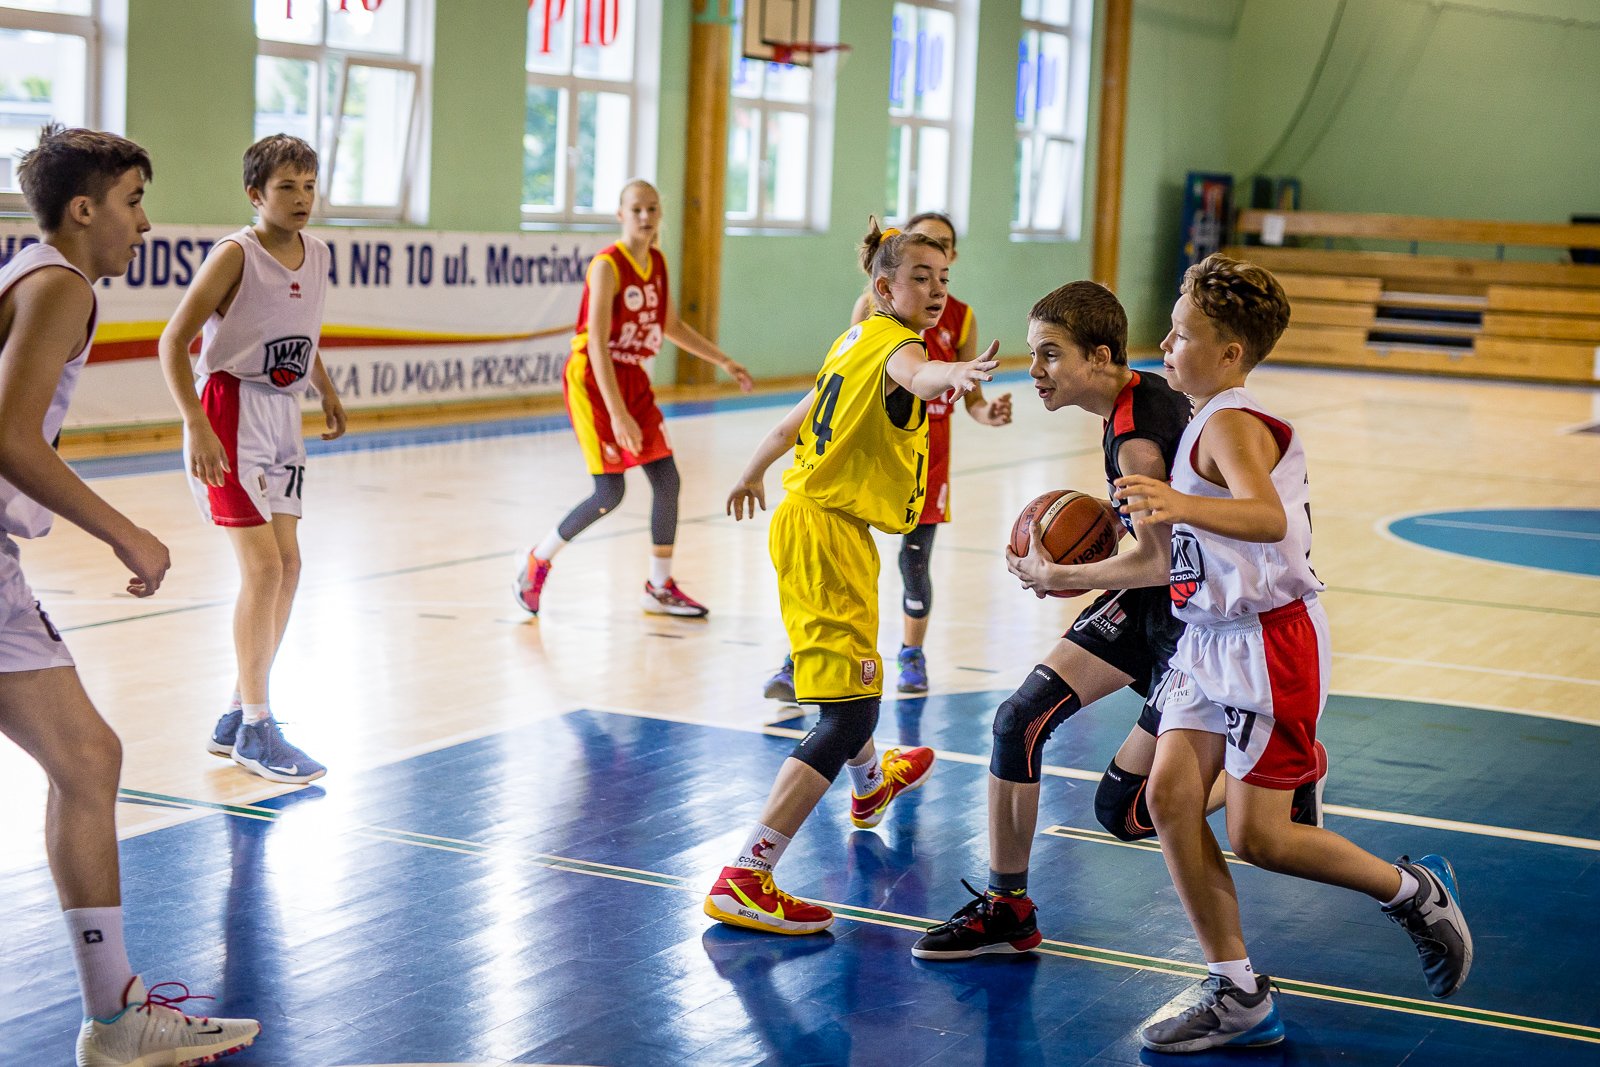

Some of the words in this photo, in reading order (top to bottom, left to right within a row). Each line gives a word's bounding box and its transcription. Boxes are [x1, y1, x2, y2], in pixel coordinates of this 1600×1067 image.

[351, 242, 391, 287] NR
[405, 243, 434, 287] 10
[444, 243, 476, 287] ul.
[487, 244, 593, 285] Morcink
[402, 358, 464, 393] MOJA
[1095, 614, 1118, 634] CTIVE
[737, 908, 760, 921] MISIA
